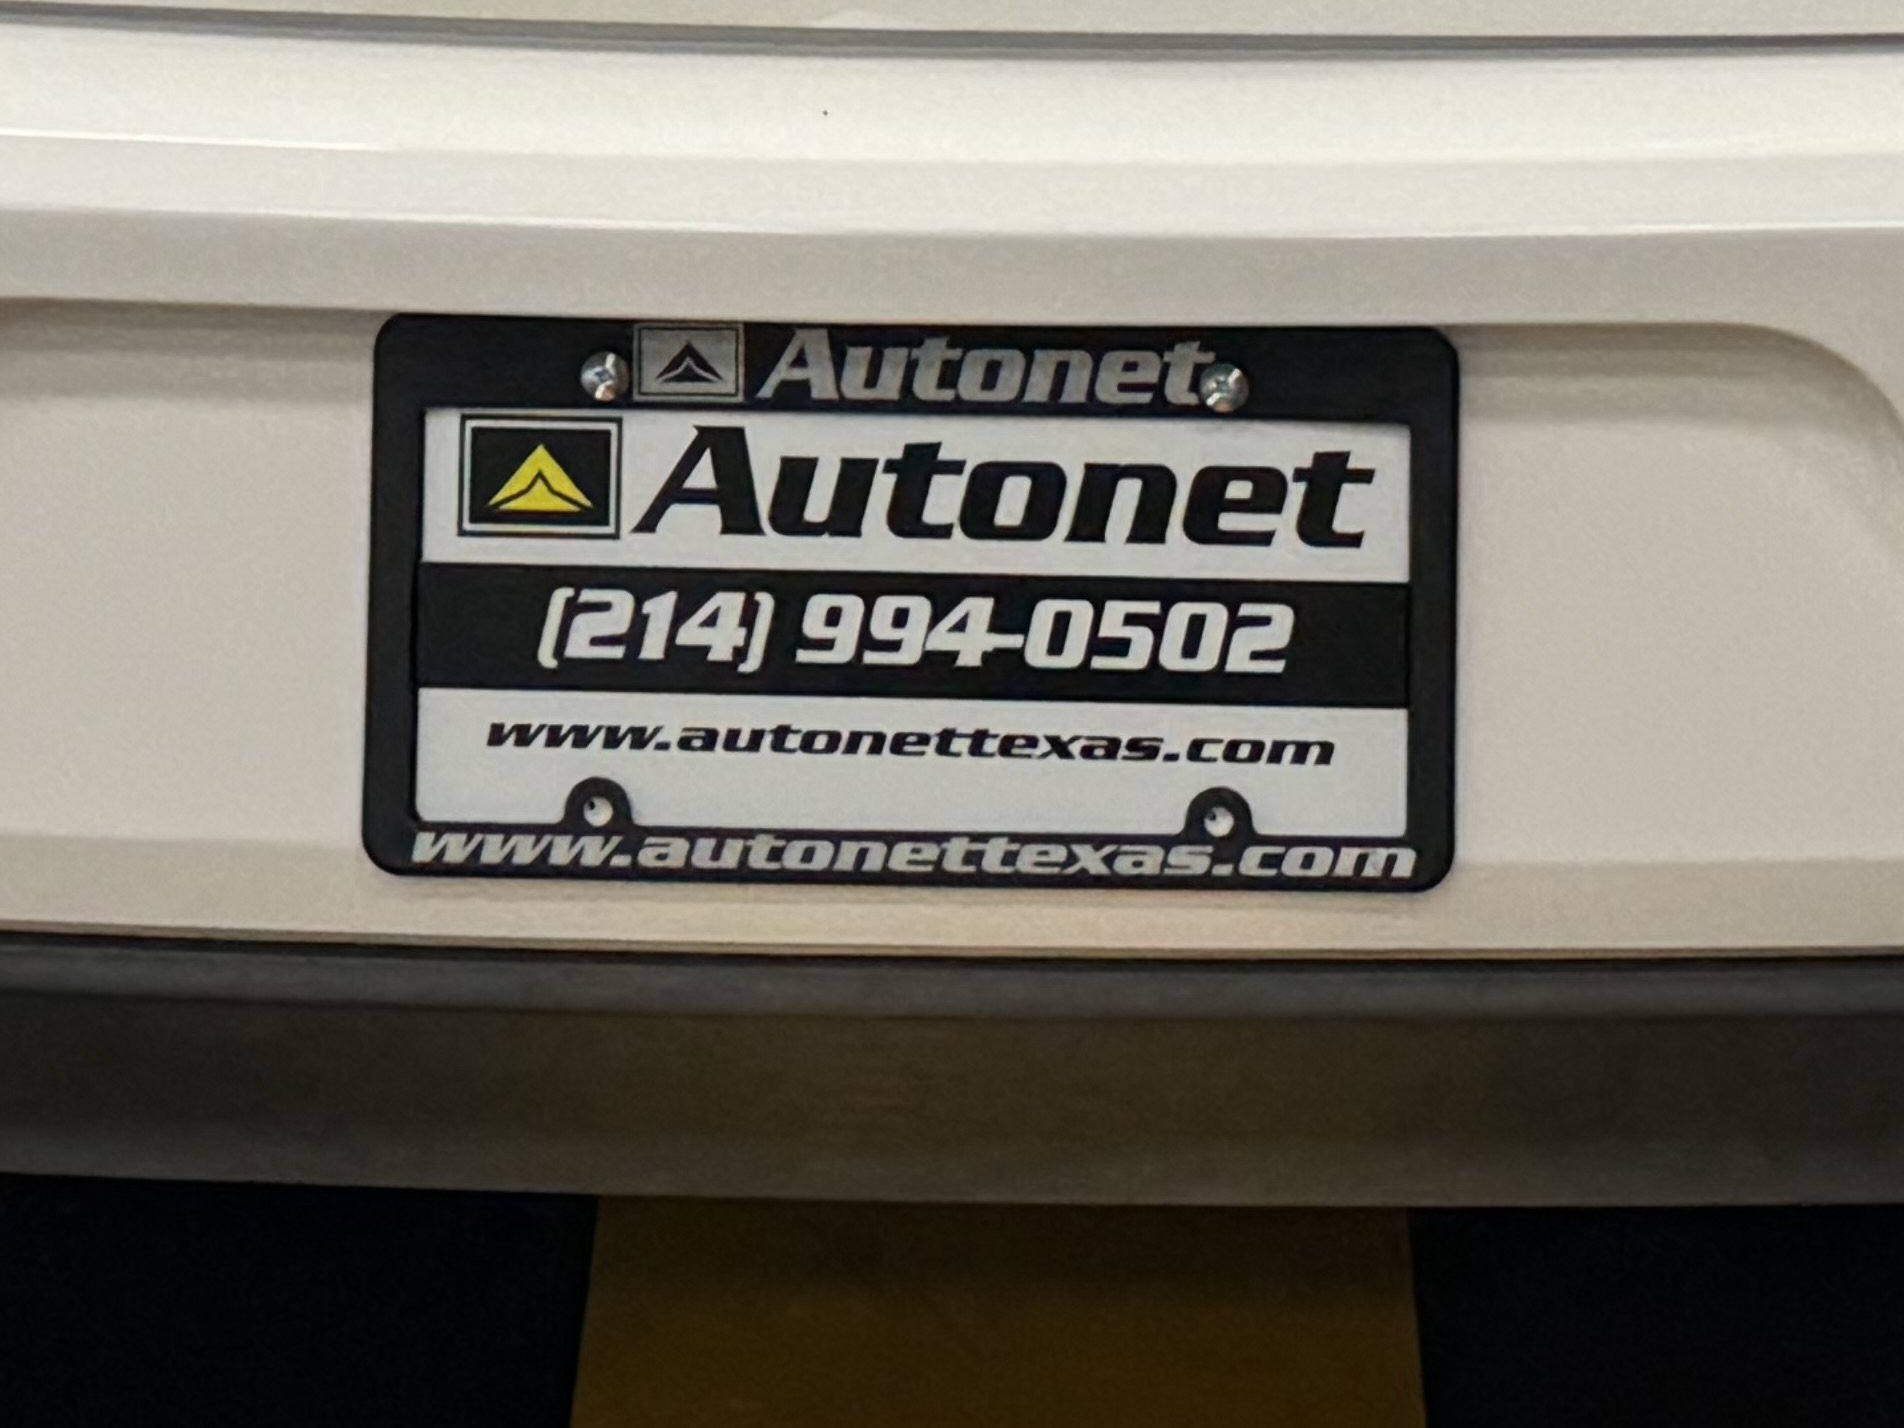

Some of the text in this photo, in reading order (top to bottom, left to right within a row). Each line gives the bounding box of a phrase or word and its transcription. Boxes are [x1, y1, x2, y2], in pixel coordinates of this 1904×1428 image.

[757, 327, 1216, 406] Autonet
[631, 424, 1375, 548] Autonet
[537, 587, 1296, 674] (214) 994-0502
[485, 720, 1336, 766] www.autonettexas.com
[411, 830, 1418, 880] www.autonettexas.com
